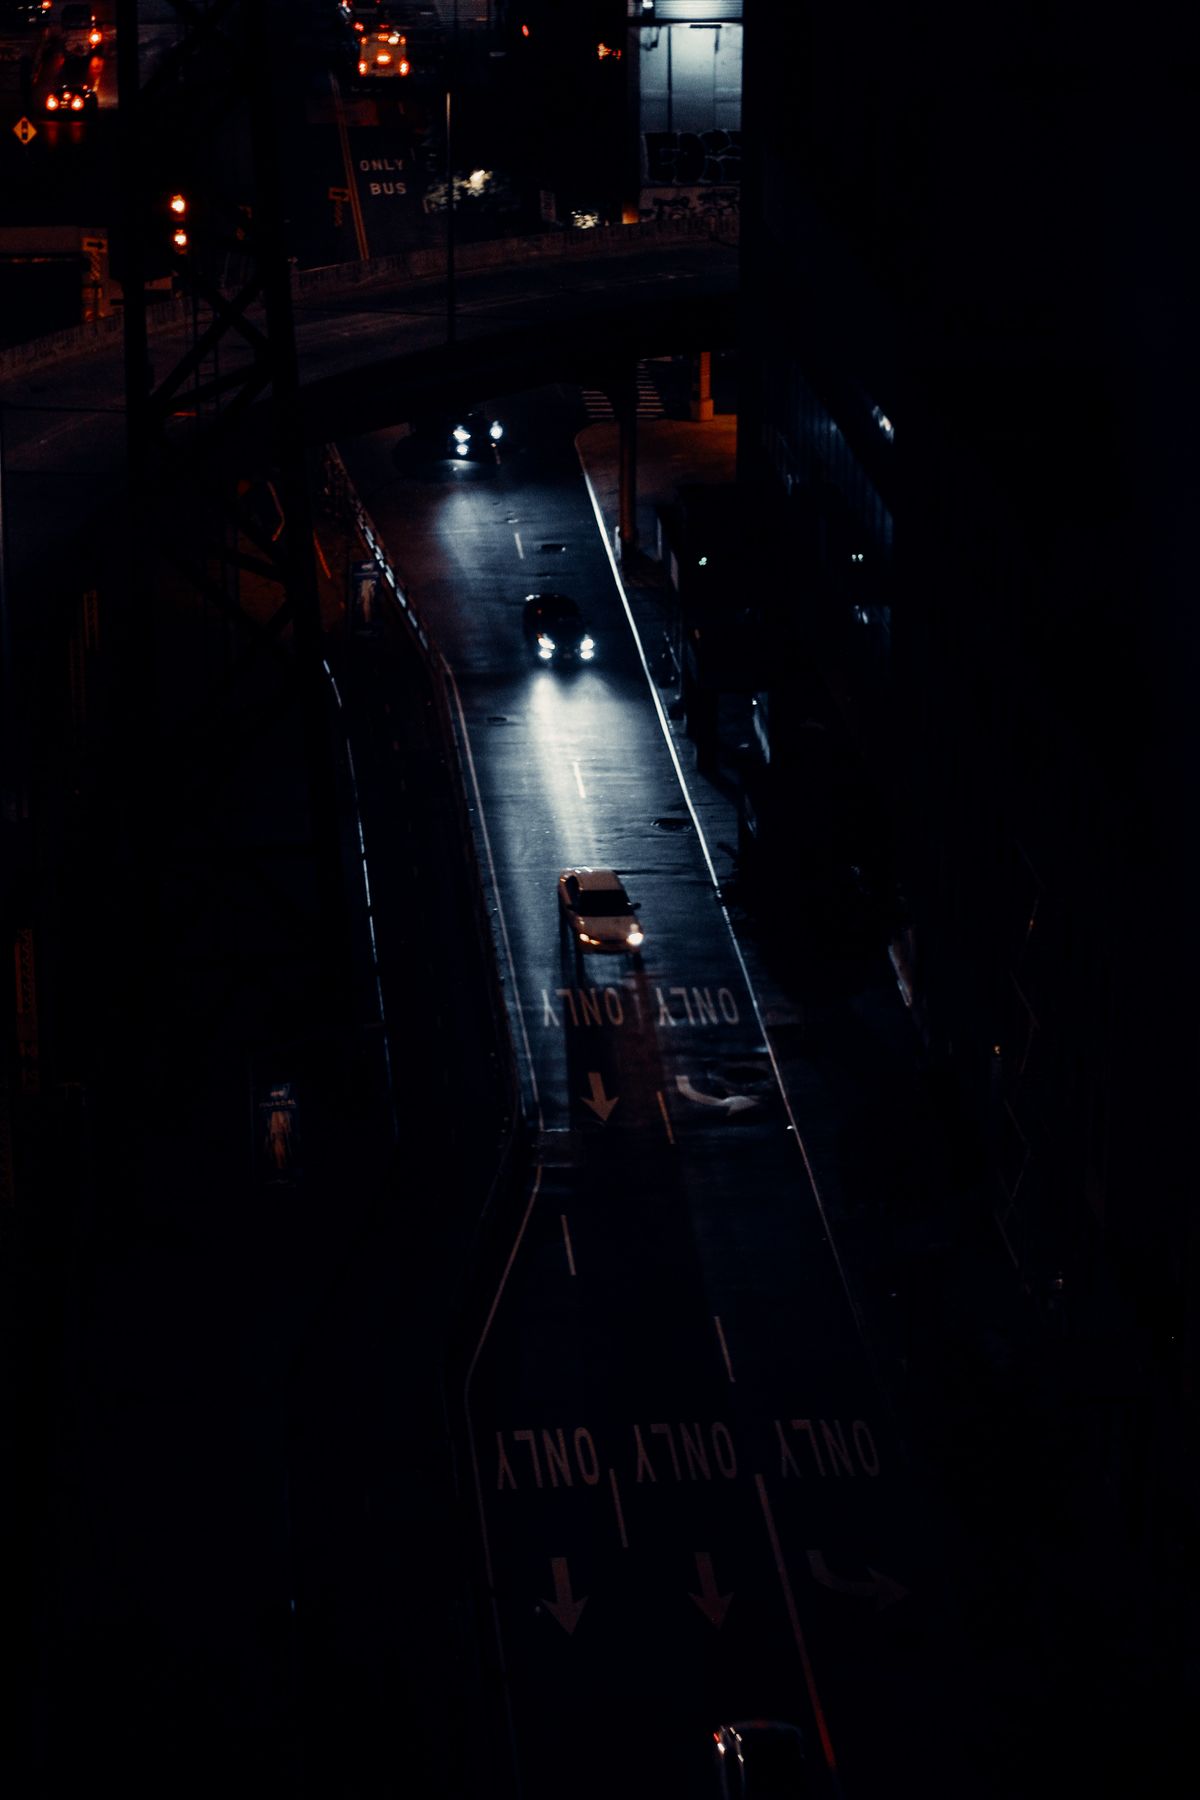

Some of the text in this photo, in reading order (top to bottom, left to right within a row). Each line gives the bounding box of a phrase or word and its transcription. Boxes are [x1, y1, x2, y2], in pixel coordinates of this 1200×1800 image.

[359, 159, 406, 172] ONLY
[369, 182, 407, 196] BUS
[541, 986, 624, 1028] ONLY
[657, 986, 740, 1027] ONLY
[495, 1425, 600, 1490] ONLY
[632, 1421, 739, 1485] ONLY
[773, 1418, 881, 1479] ONLY
